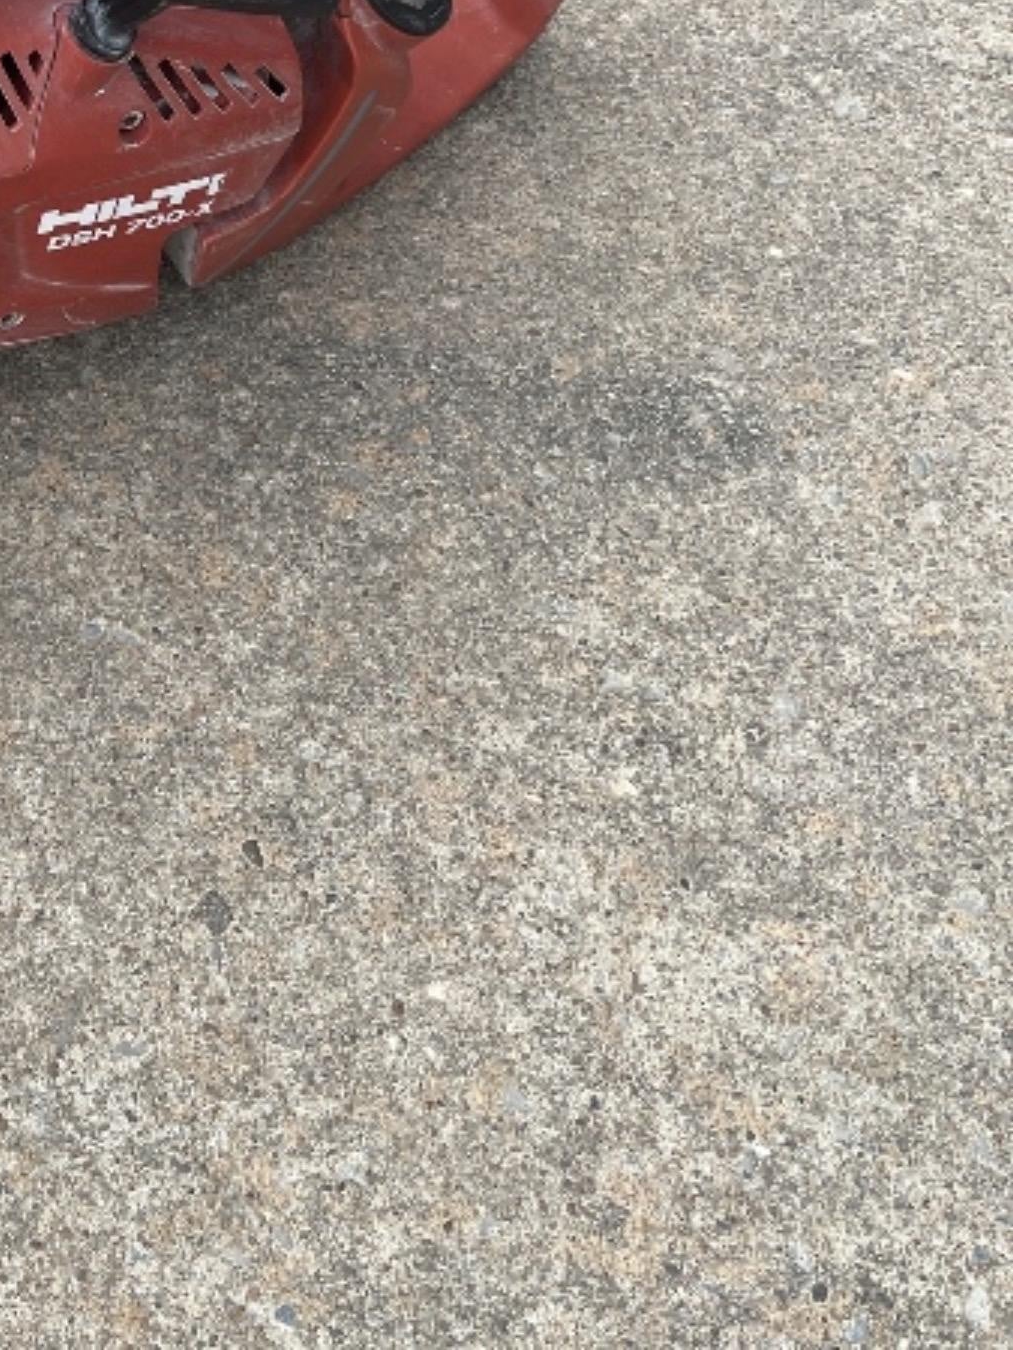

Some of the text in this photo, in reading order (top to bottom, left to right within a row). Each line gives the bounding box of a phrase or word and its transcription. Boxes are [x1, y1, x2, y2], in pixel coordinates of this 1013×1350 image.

[37, 172, 227, 236] HILTI
[46, 198, 216, 252] DSH 700-X
